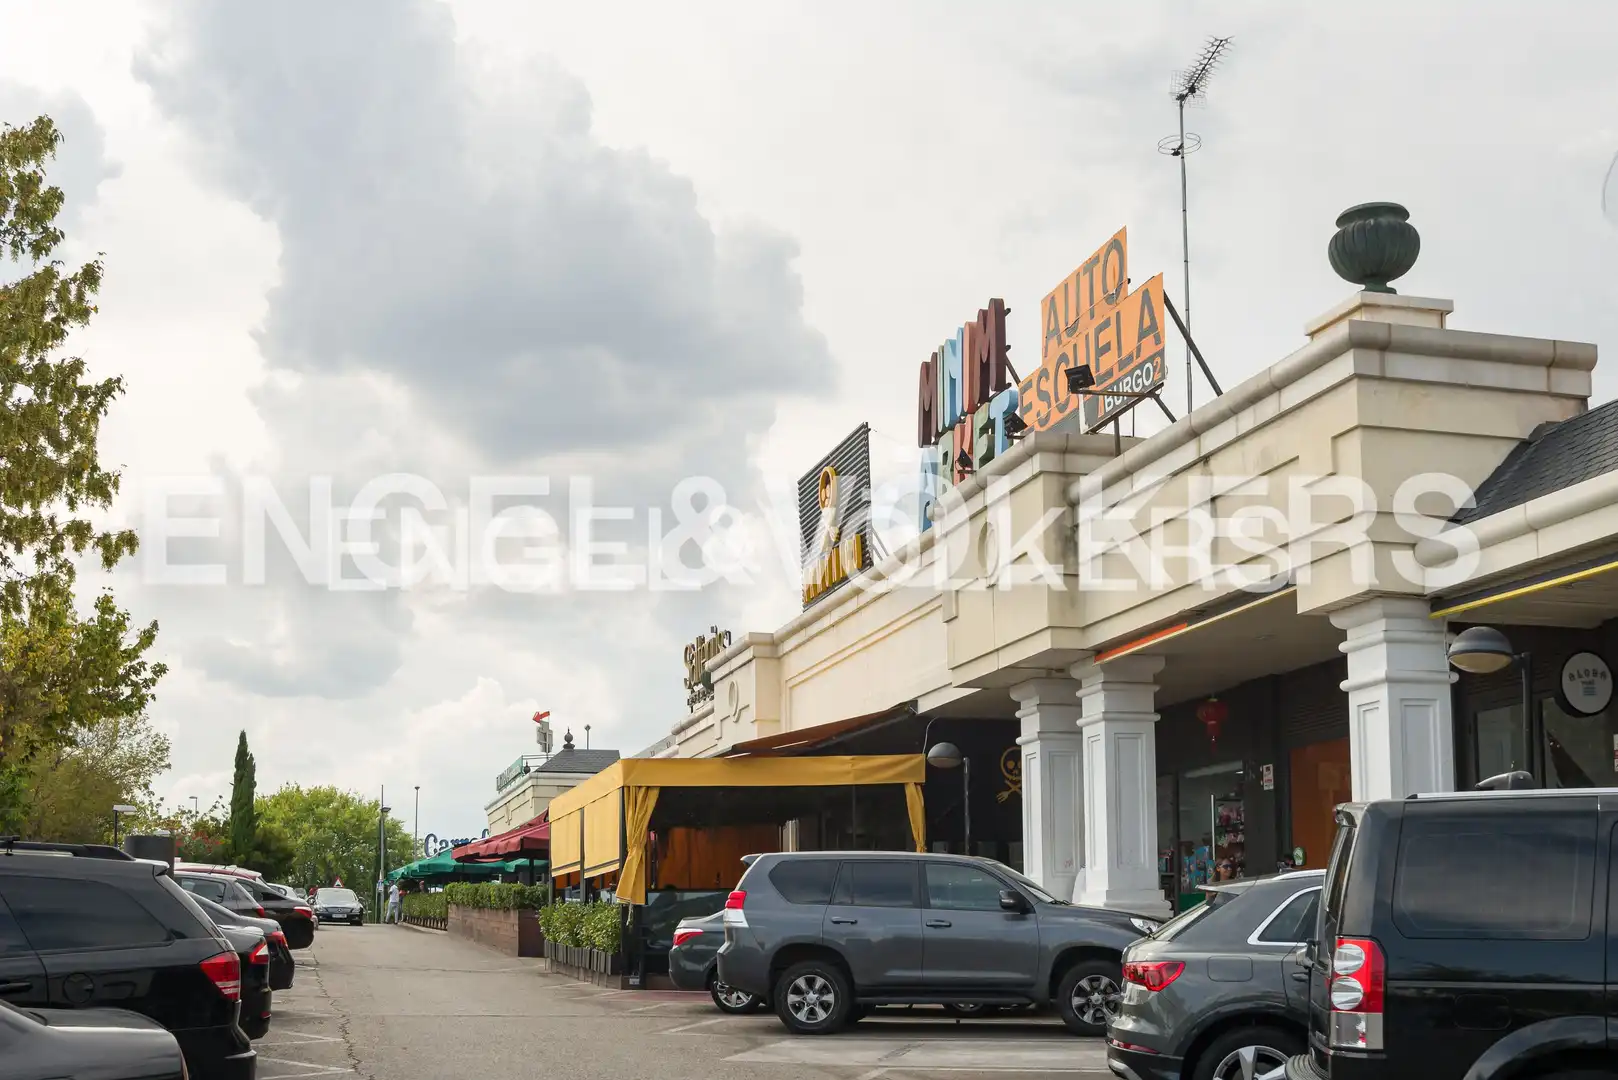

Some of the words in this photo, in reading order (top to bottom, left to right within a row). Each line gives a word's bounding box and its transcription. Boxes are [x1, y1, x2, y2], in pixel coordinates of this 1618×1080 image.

[1019, 288, 1162, 430] ESCUELA
[1044, 238, 1125, 358] AUTO
[918, 298, 1006, 448] MINIM
